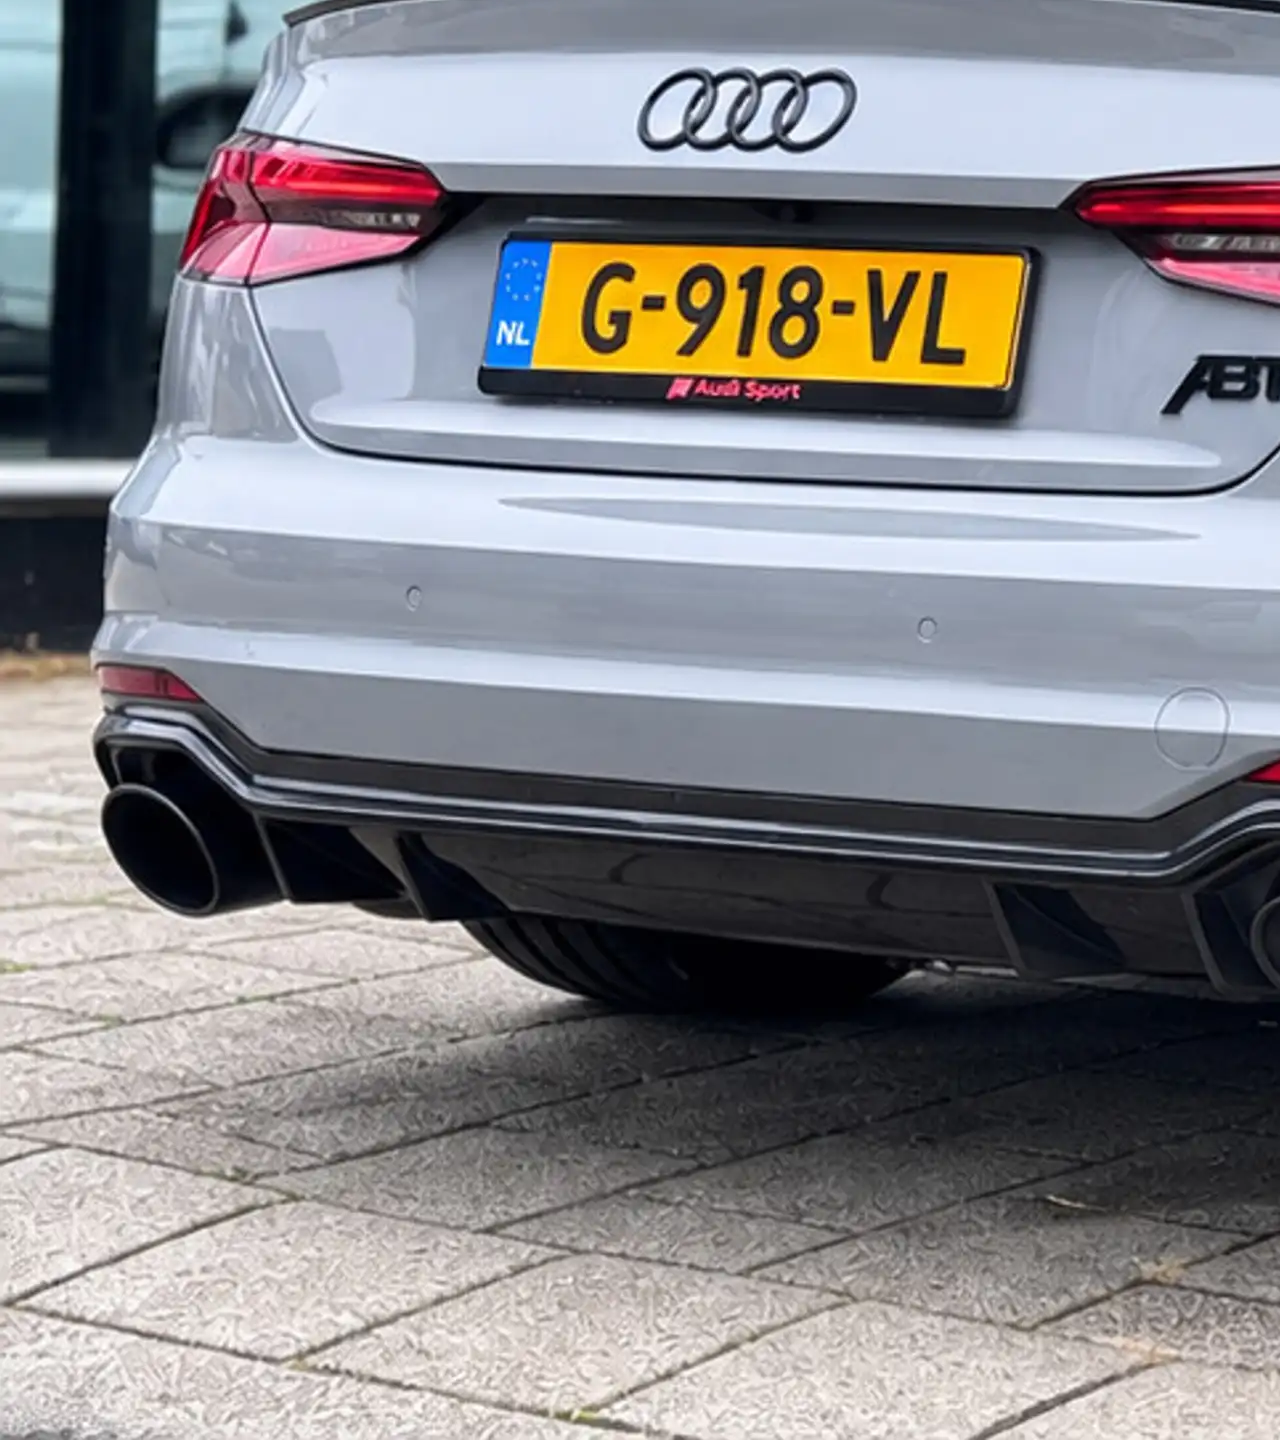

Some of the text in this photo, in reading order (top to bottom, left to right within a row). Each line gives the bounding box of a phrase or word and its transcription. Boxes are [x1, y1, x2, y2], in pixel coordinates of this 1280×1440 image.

[580, 261, 967, 366] G-918-VL
[495, 319, 531, 347] NL
[695, 378, 801, 402] Audi Sport
